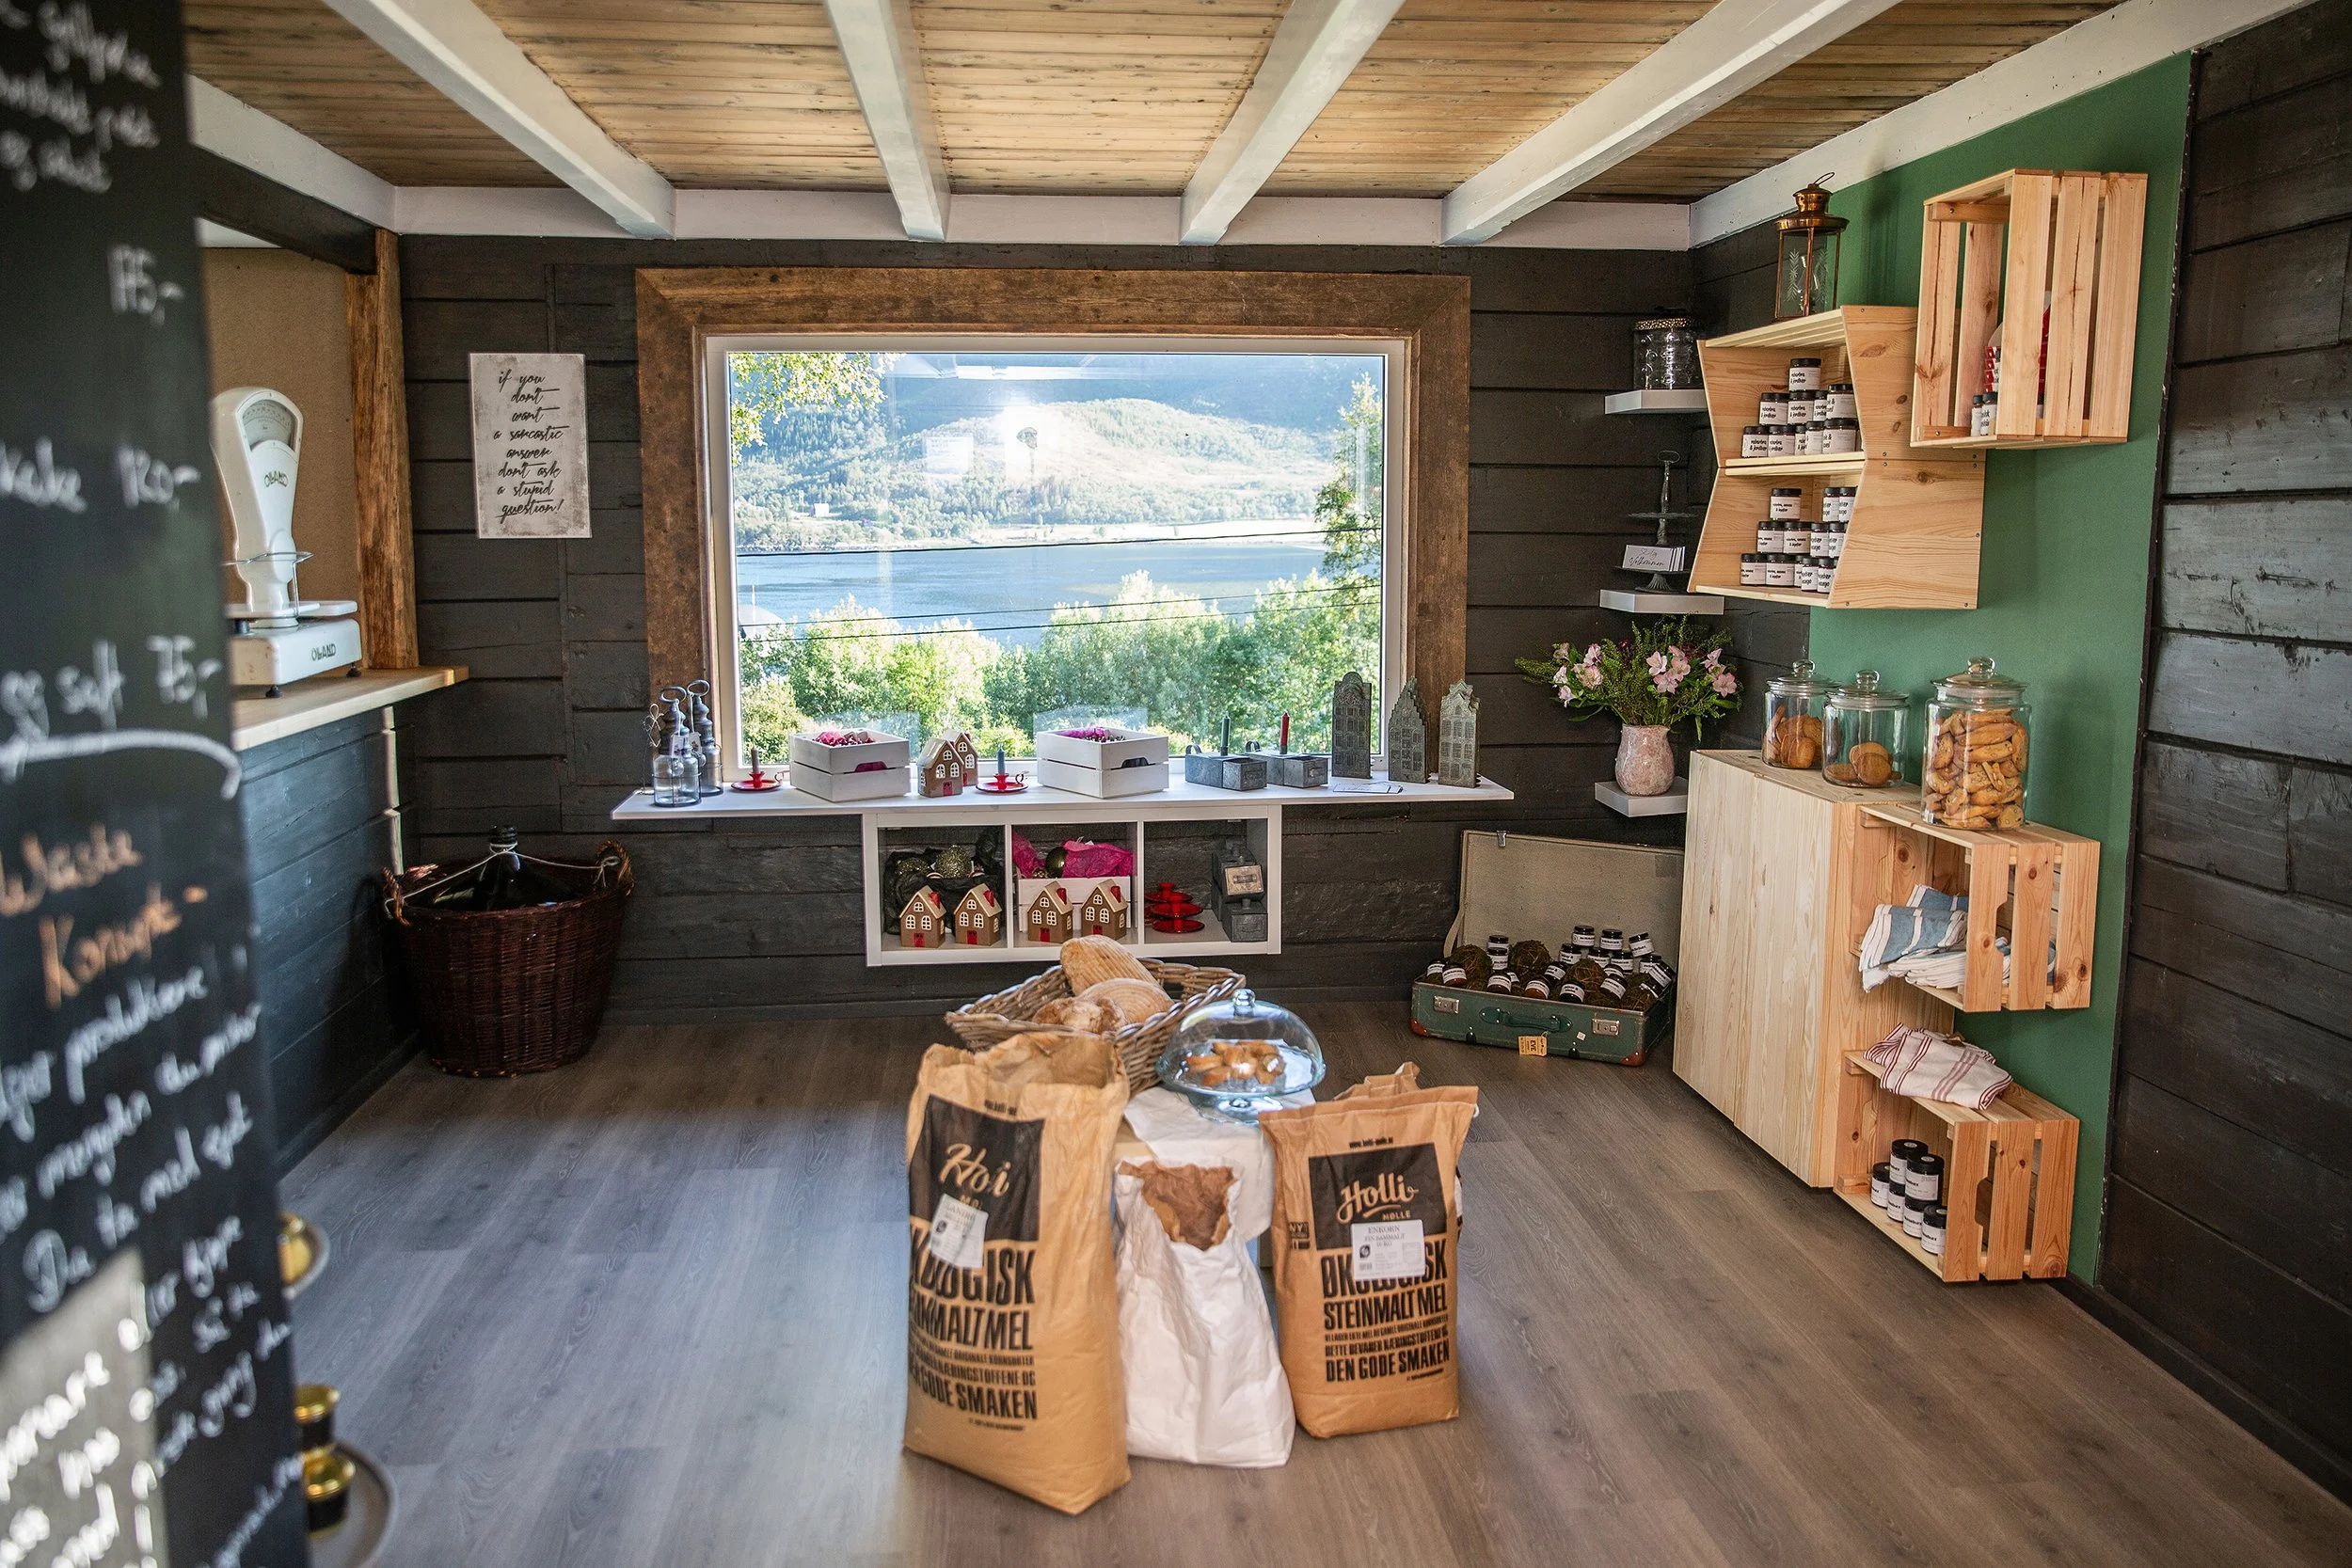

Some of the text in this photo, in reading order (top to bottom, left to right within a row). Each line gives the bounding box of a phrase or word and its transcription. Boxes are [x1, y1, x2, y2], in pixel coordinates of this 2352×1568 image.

[499, 369, 546, 393] if you
[512, 406, 561, 423] want
[494, 425, 569, 442] a sarcastic
[506, 448, 552, 460] answer
[537, 460, 562, 477] ask
[497, 480, 555, 505] a stupid
[496, 499, 564, 524] question!
[1336, 1173, 1419, 1223] Holli
[1368, 1225, 1401, 1234] ENKORN
[1324, 1282, 1448, 1331] STEINMALT MEL
[984, 1308, 1034, 1351] MEL
[1327, 1358, 1355, 1382] DEN
[1359, 1353, 1396, 1380] GODE
[1399, 1338, 1449, 1373] SMAKEN
[1022, 1370, 1036, 1386] OG
[956, 1382, 1039, 1420] SMAKEN
